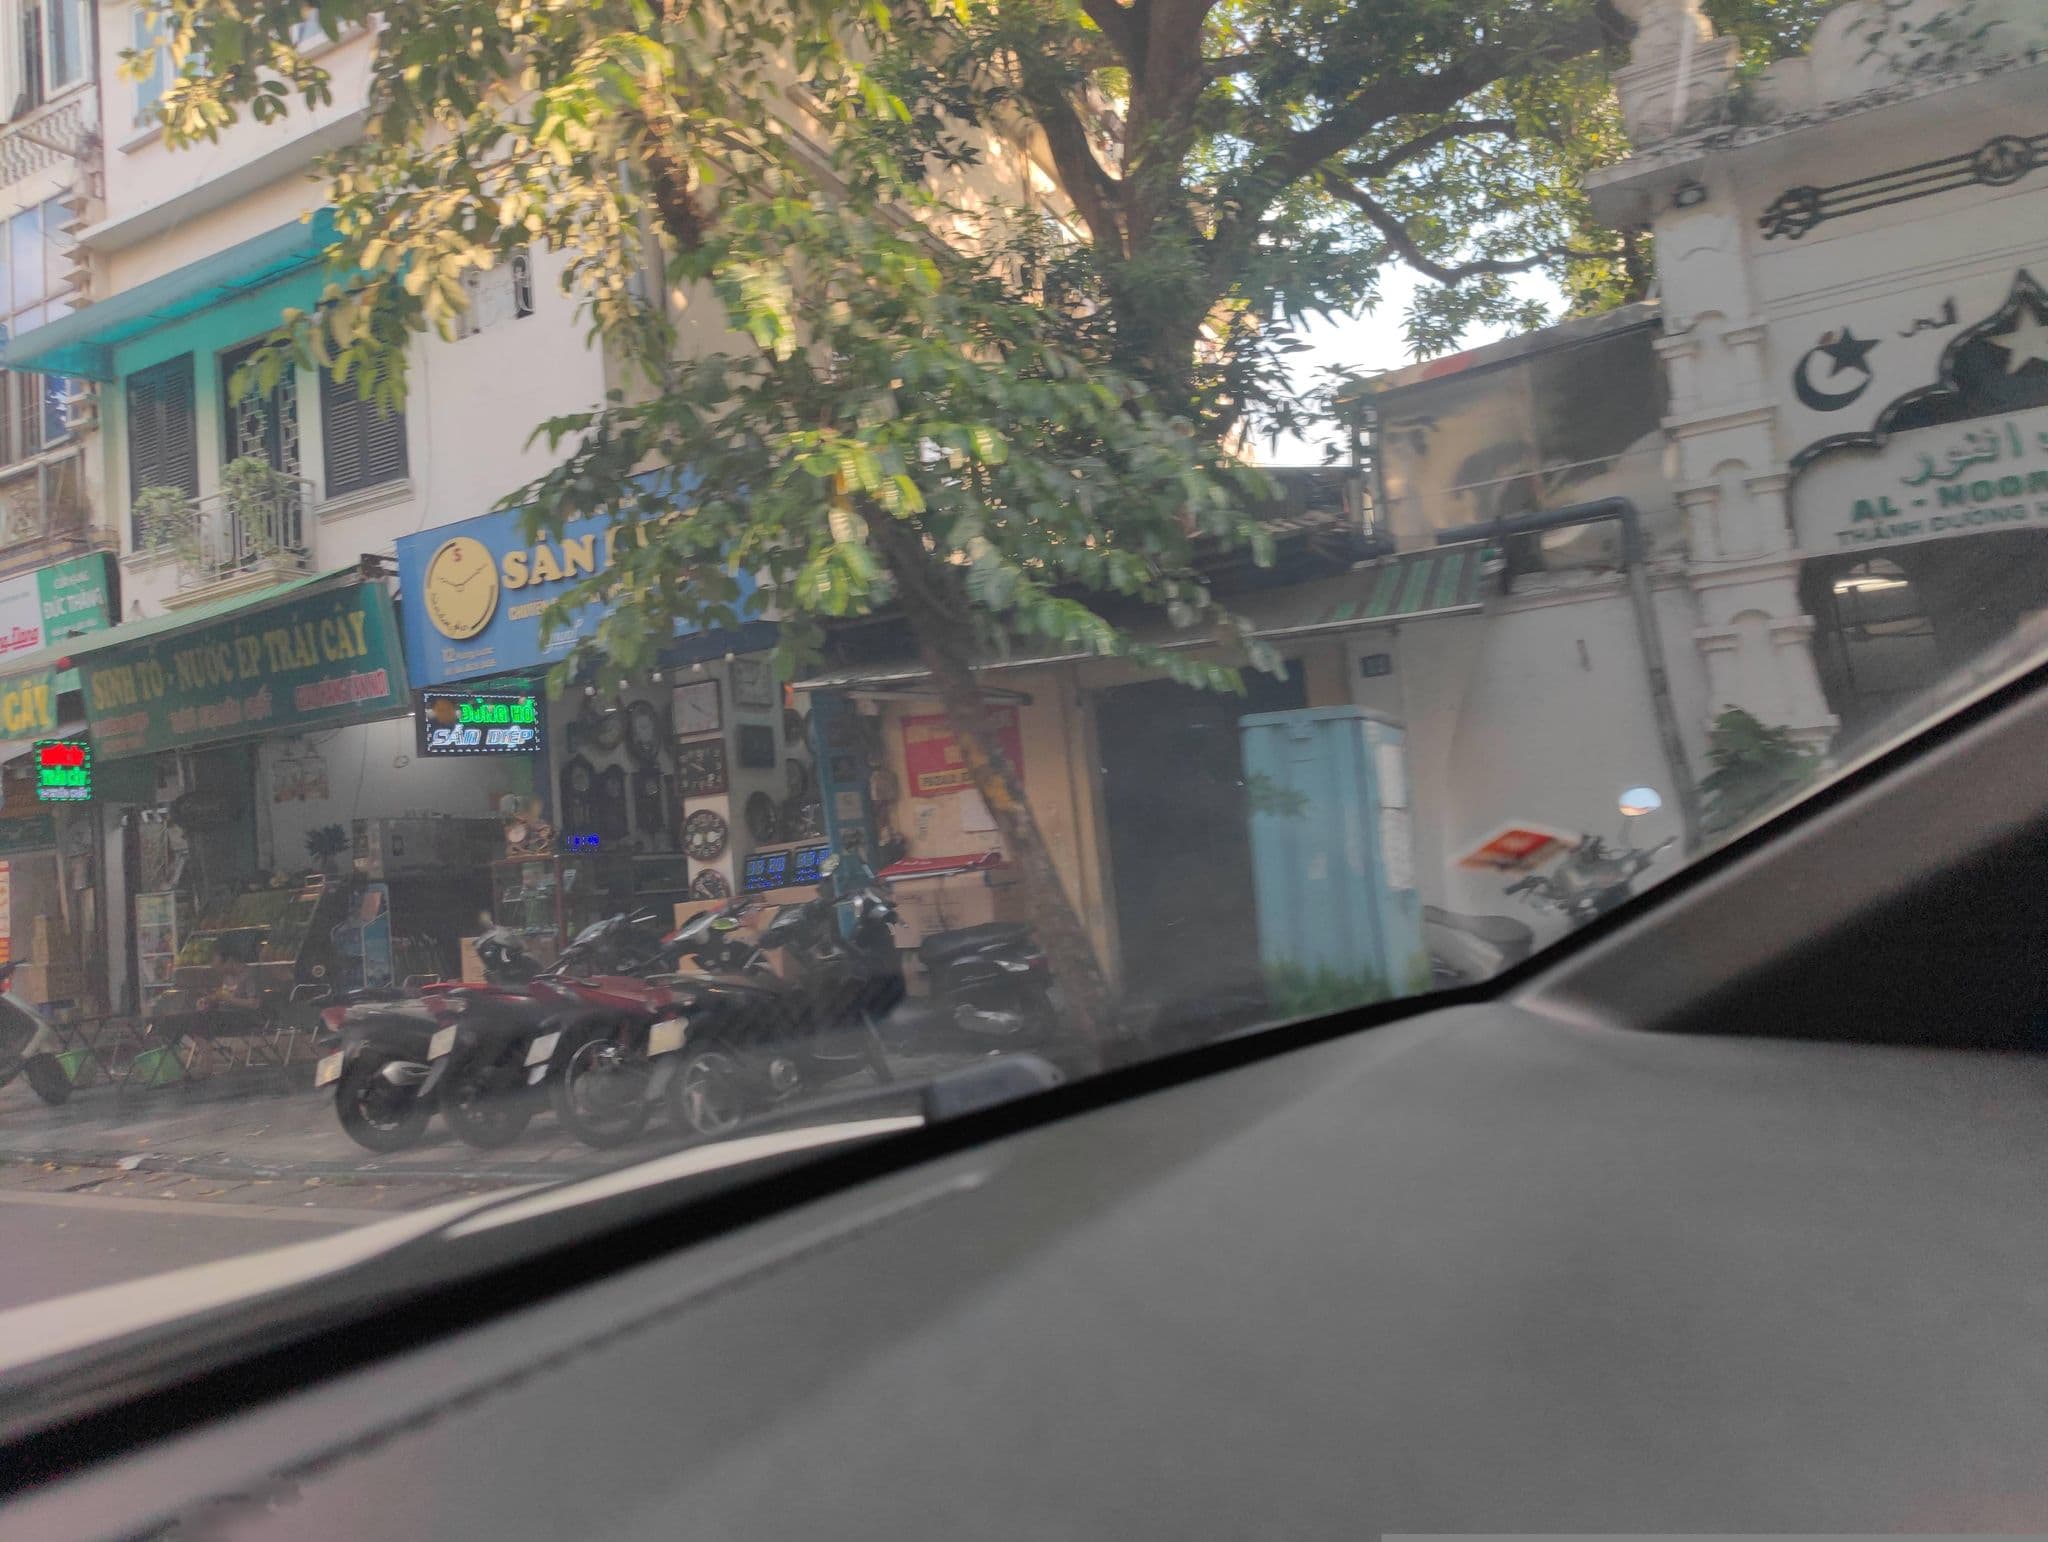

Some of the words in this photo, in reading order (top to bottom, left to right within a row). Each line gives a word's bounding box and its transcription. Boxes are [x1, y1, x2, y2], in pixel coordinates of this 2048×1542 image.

[1852, 496, 1899, 523] AL
[320, 601, 368, 662] CÂY
[3, 680, 49, 732] CÂY
